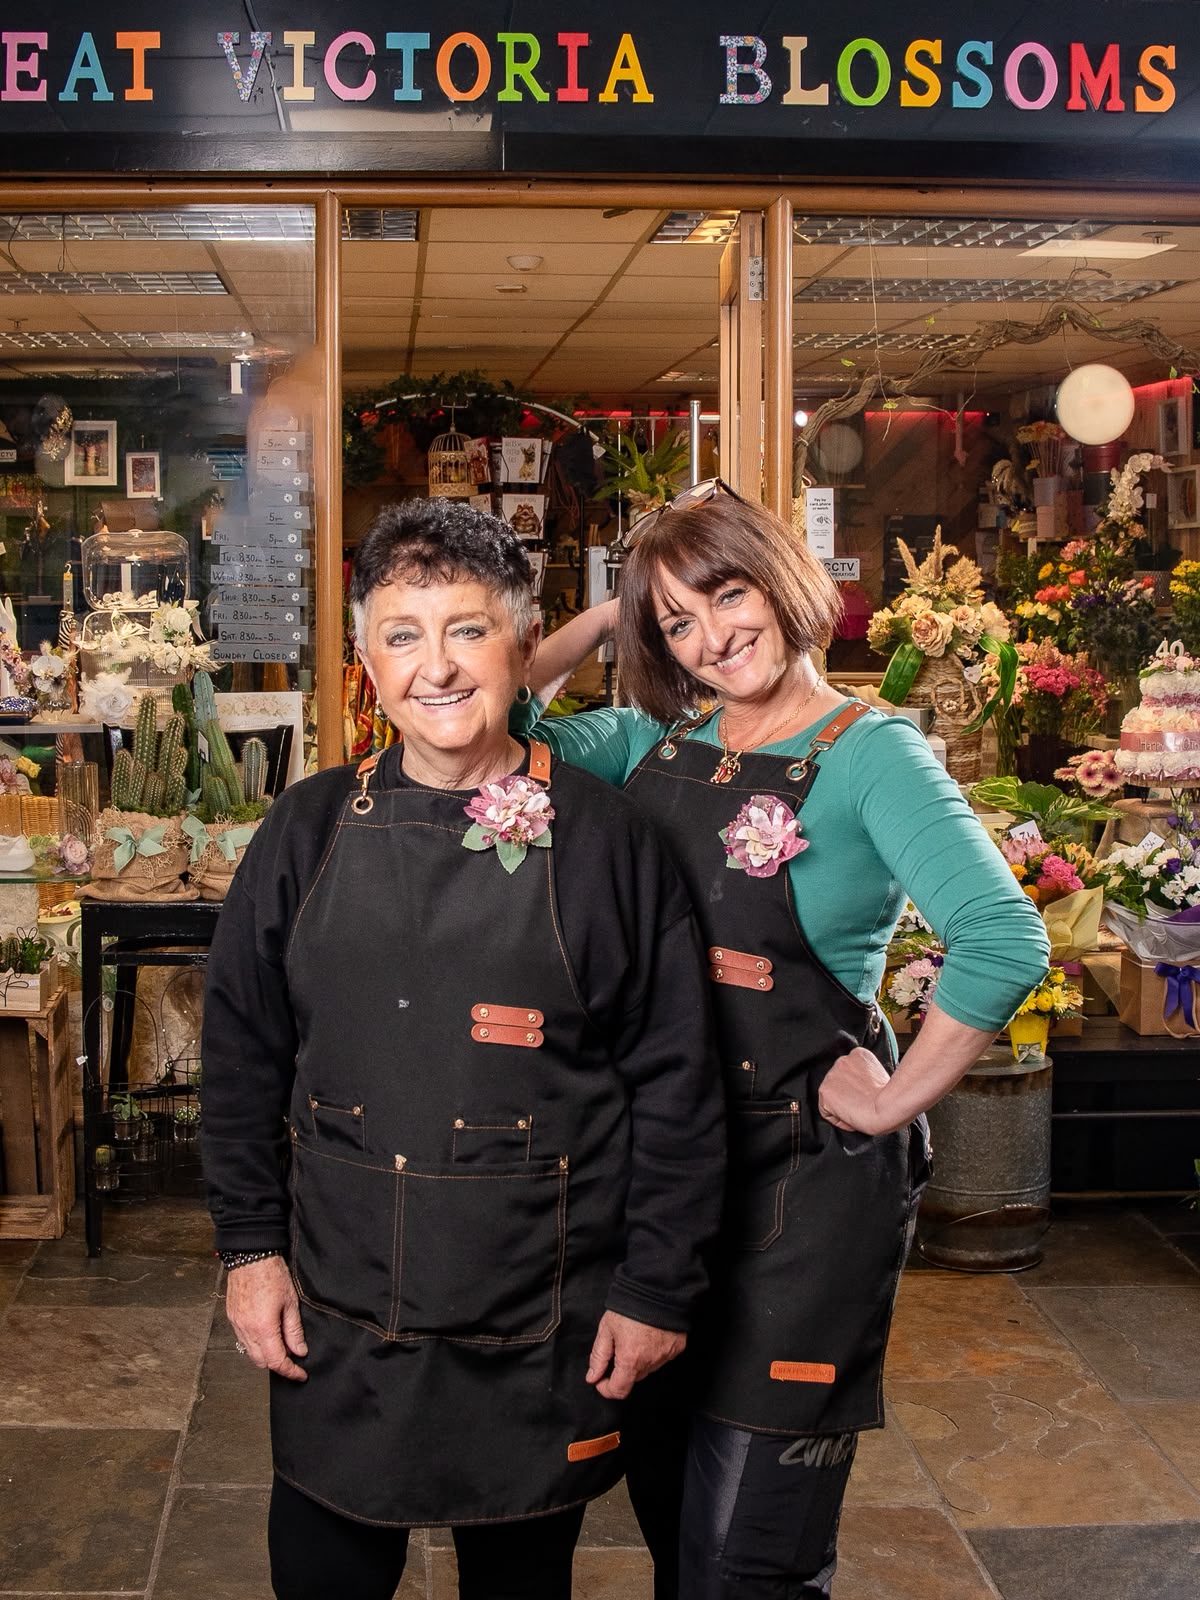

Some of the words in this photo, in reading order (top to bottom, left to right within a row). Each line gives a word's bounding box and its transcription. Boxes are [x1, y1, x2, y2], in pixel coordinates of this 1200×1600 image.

[0, 32, 161, 102] EAT
[217, 31, 654, 103] VICTORIA
[719, 35, 1176, 113] BLOSSOMS
[825, 562, 854, 571] CCTV
